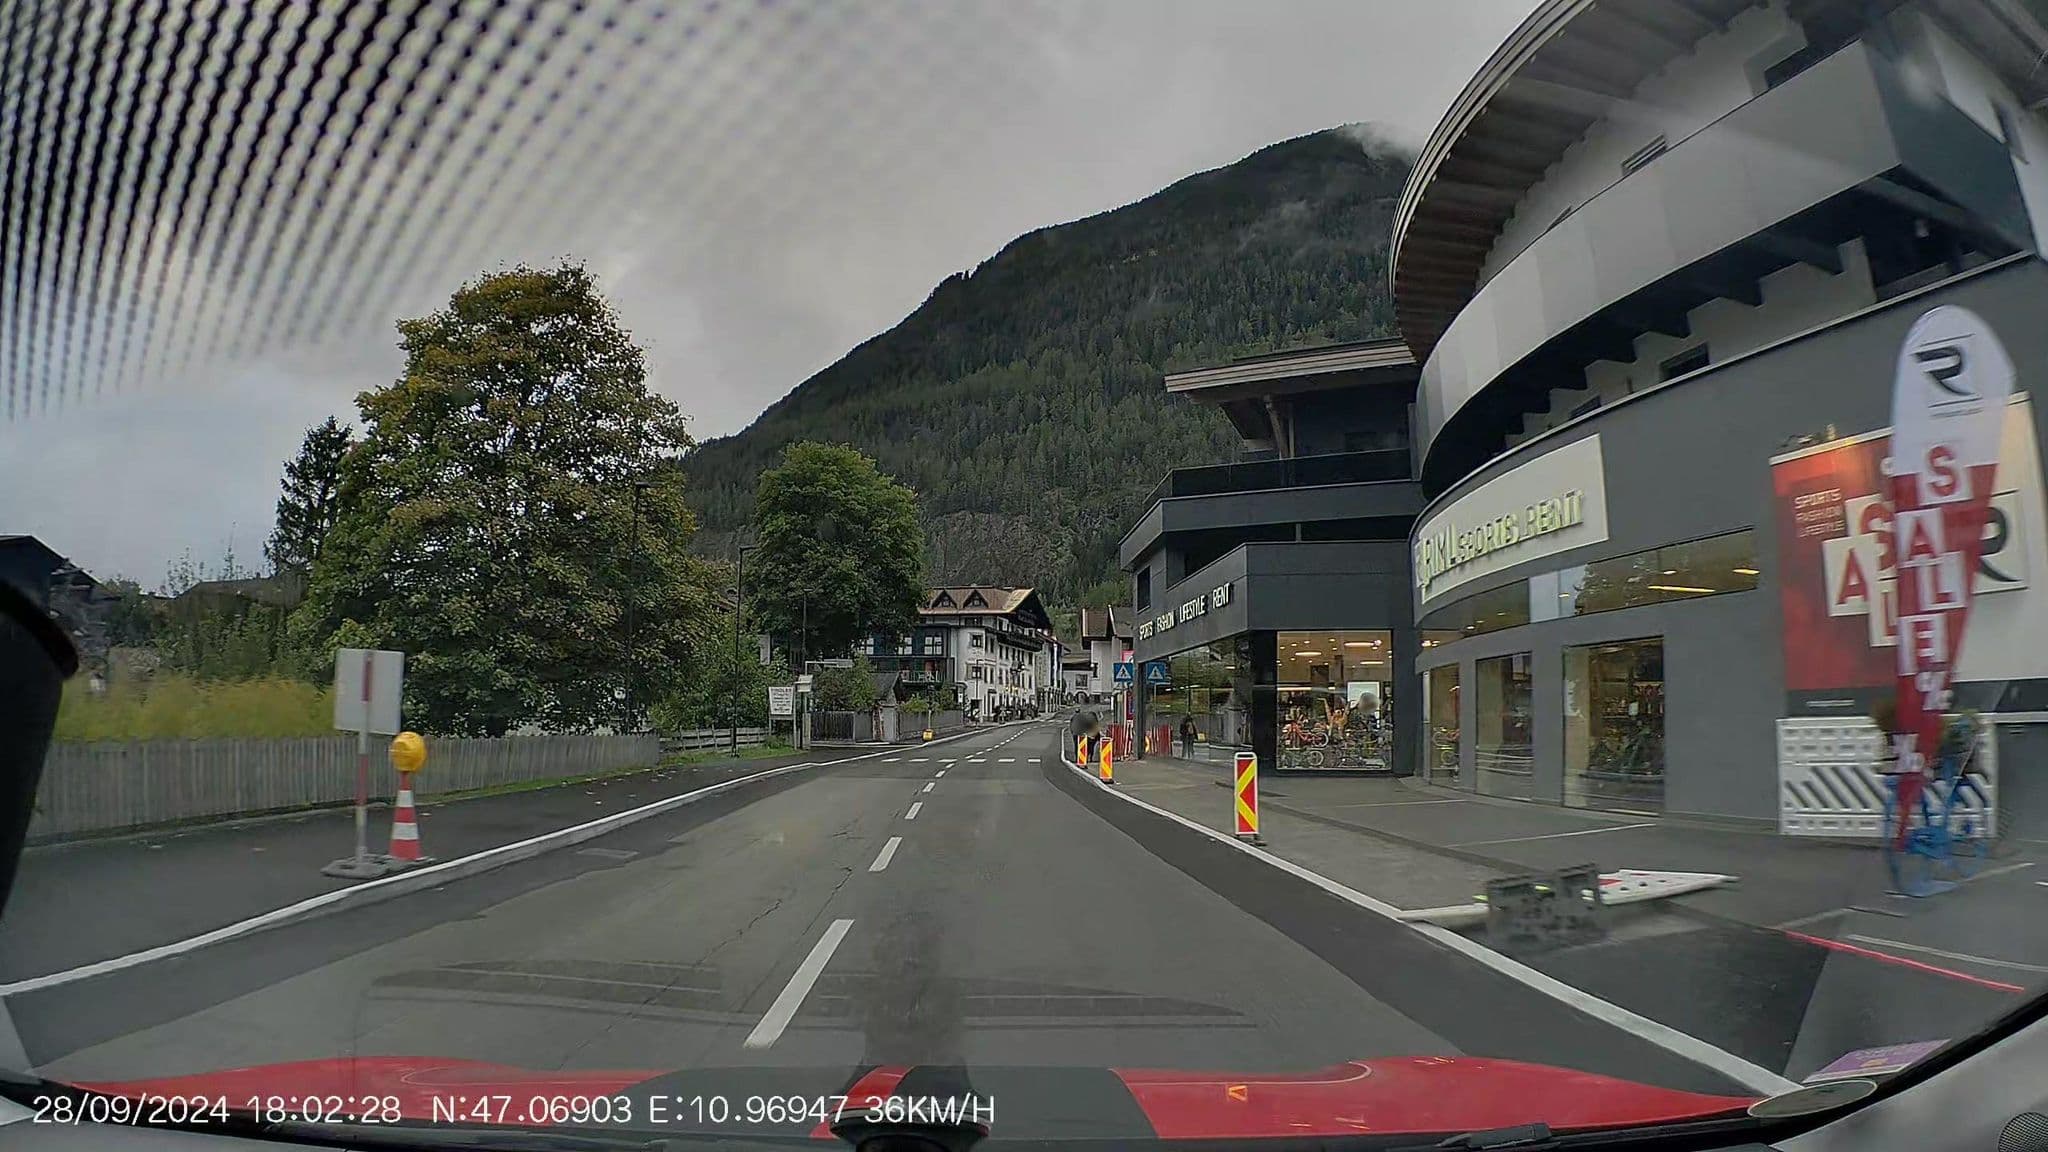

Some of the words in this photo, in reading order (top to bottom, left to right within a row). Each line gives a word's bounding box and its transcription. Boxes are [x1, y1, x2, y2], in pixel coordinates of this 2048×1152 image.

[1458, 513, 1520, 562] SPORTS
[1524, 490, 1584, 538] RENT
[1180, 595, 1206, 624] LIFESTYLE
[1213, 583, 1230, 609] RENT
